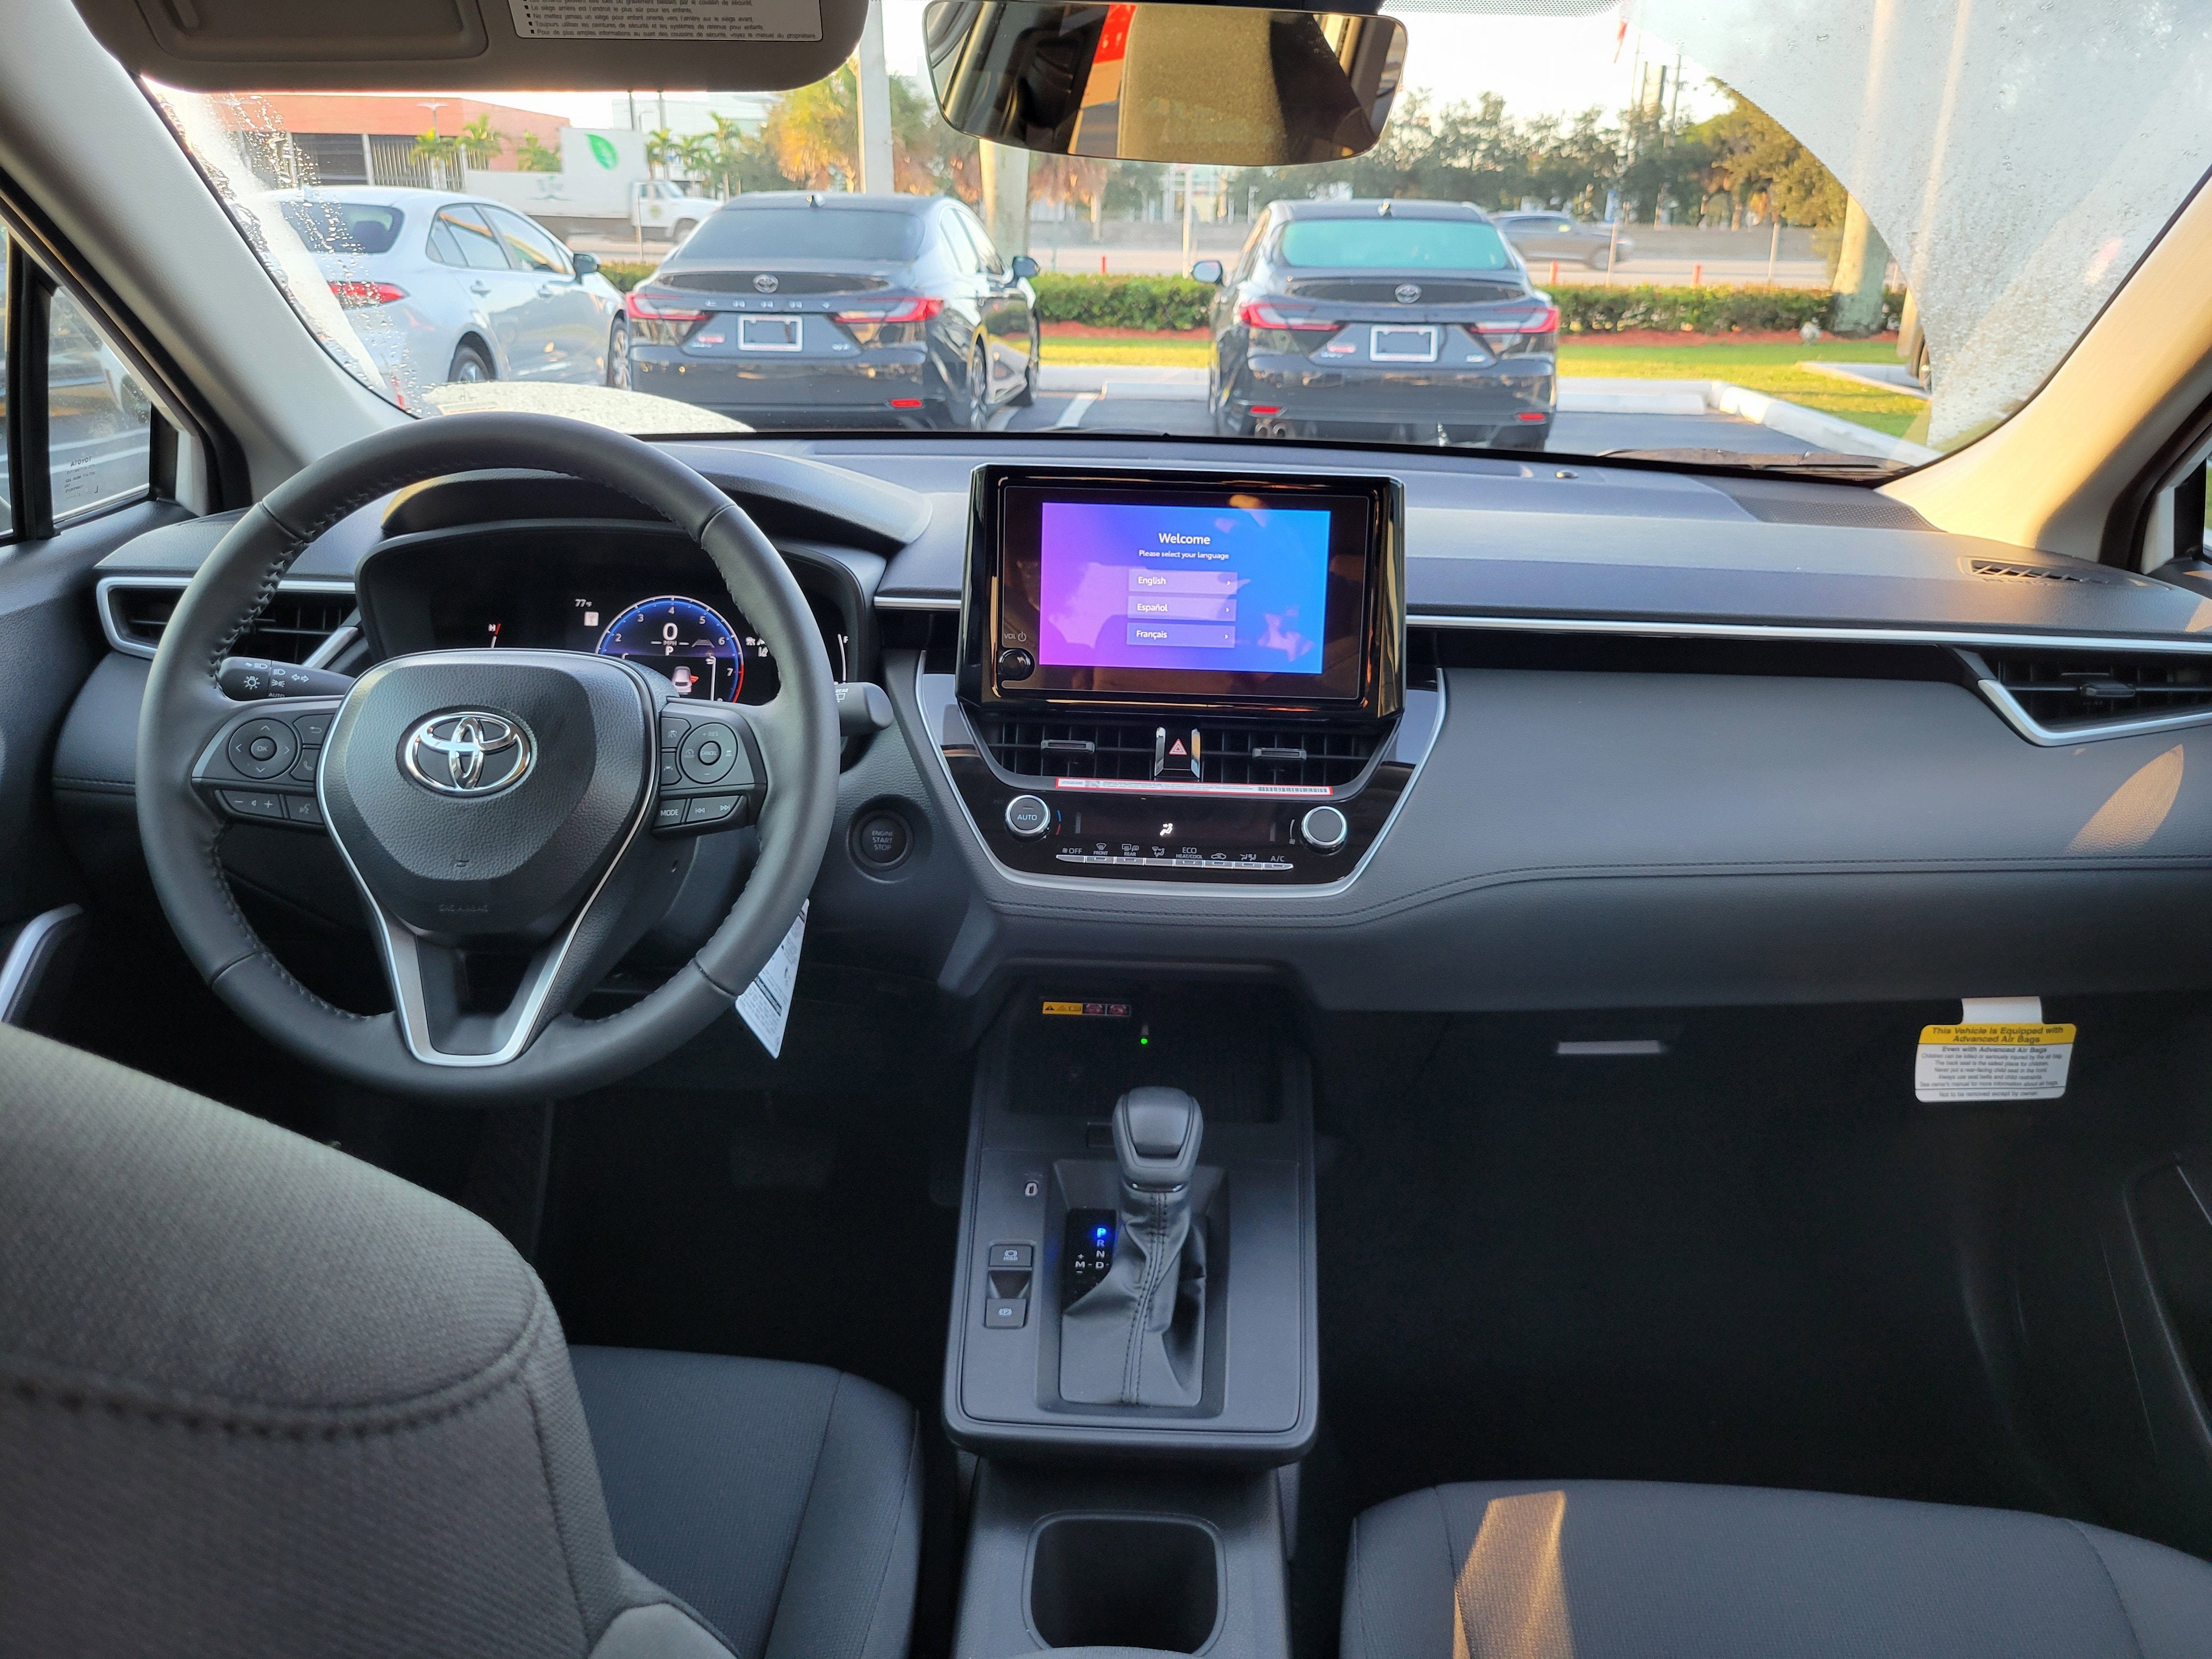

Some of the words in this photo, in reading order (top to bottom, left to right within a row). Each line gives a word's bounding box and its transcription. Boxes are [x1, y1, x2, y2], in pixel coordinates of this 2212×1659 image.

[1158, 532, 1211, 545] Welcome
[1197, 551, 1229, 560] language
[1138, 576, 1166, 586] English
[668, 606, 675, 614] 4
[1137, 603, 1168, 613] Español
[637, 614, 644, 623] 3
[698, 616, 706, 624] 5
[663, 622, 679, 641] 0
[1136, 630, 1167, 640] Français
[614, 633, 622, 642] 2
[718, 636, 725, 645] 6
[665, 646, 674, 656] P
[726, 667, 733, 676] 7
[660, 809, 679, 817] MODE
[2000, 1026, 2043, 1035] Equipped
[2017, 1035, 2040, 1043] Bags
[1097, 1227, 1107, 1238] P
[1097, 1239, 1105, 1247] R
[1096, 1250, 1105, 1259] N
[1095, 1261, 1104, 1269] D
